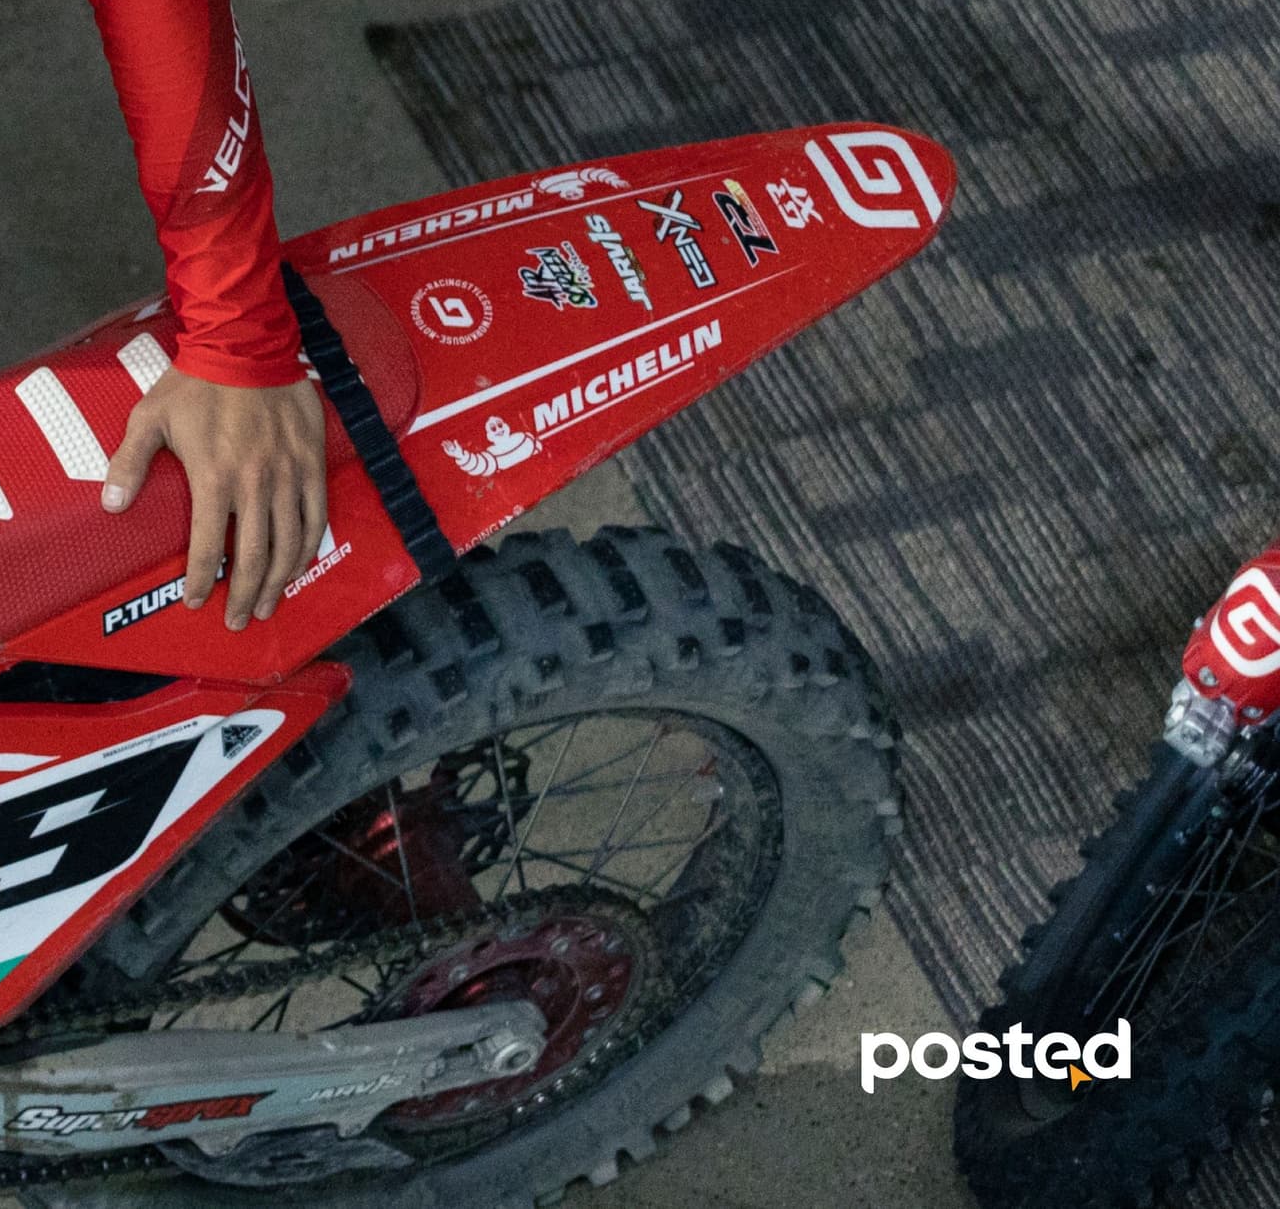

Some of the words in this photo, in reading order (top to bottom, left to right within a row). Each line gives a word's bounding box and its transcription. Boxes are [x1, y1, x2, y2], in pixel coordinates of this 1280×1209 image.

[328, 190, 535, 264] MICHELIN
[584, 214, 654, 312] JARVIS
[533, 319, 723, 433] MICHELIN
[284, 541, 352, 599] GRIPPER
